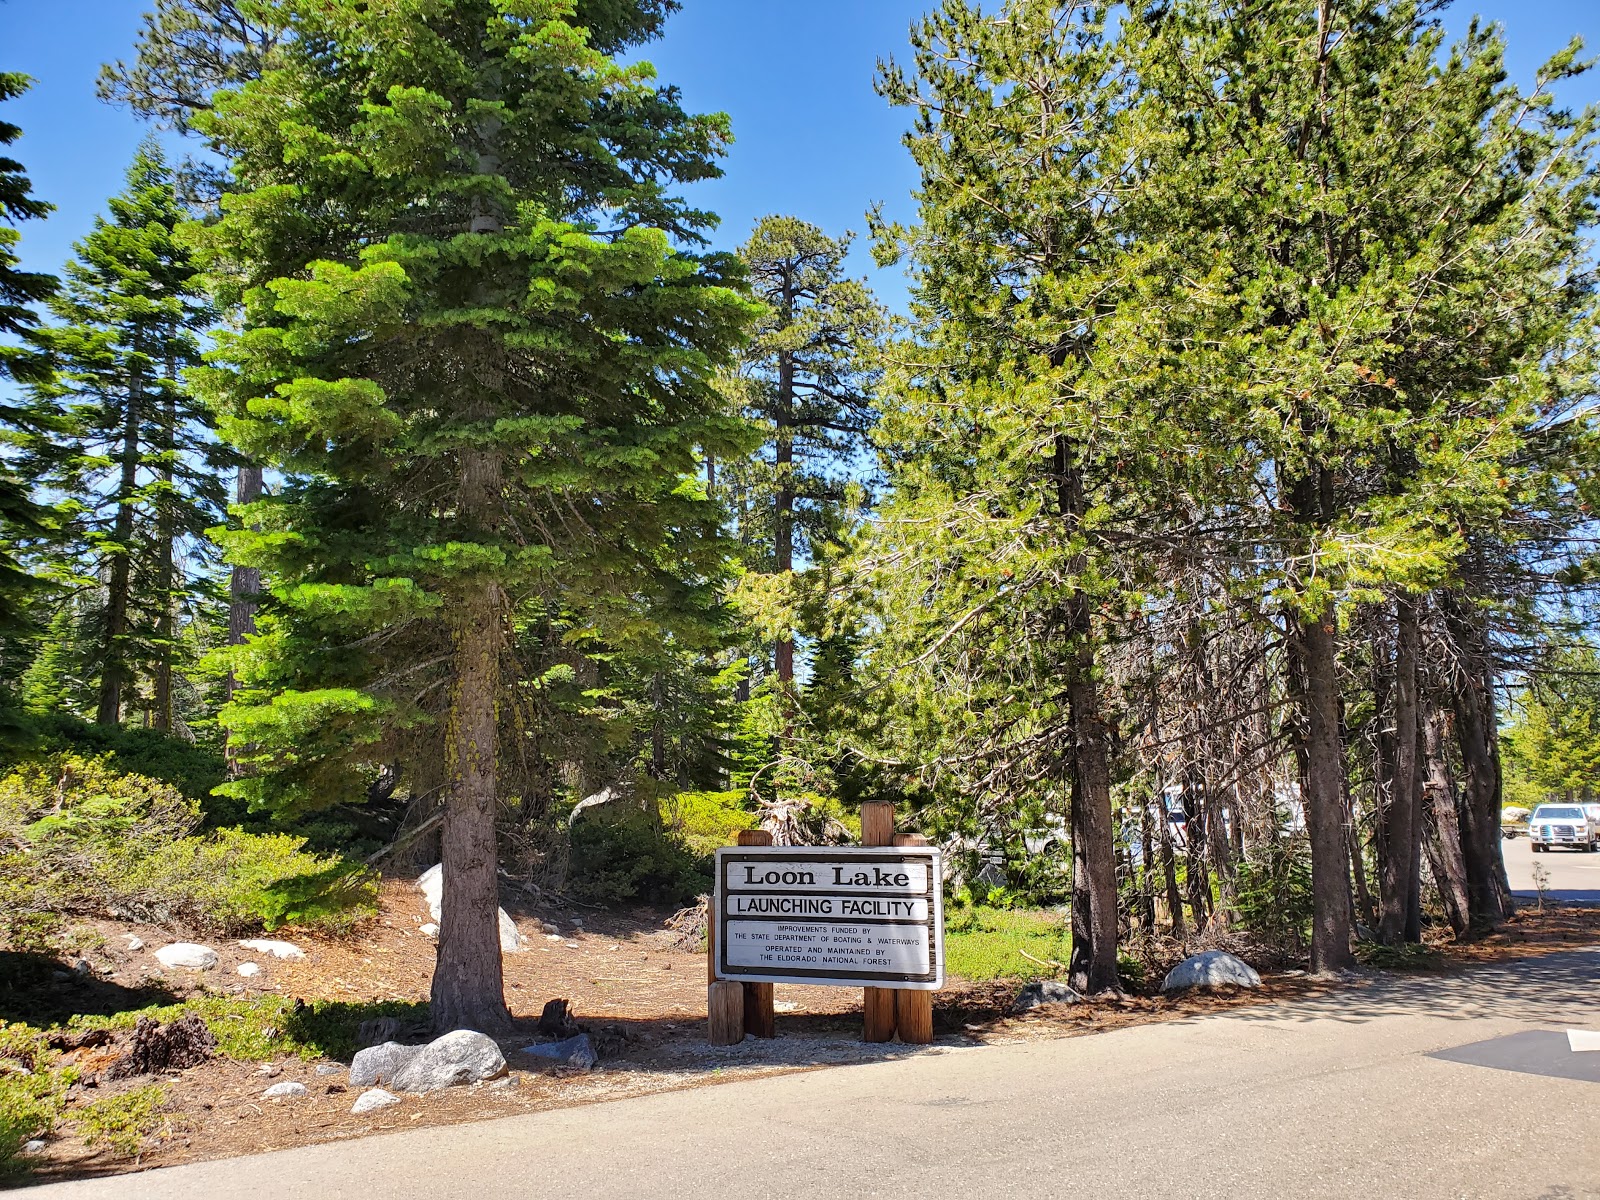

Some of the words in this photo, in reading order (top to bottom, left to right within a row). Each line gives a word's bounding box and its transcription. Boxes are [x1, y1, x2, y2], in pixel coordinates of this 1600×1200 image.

[744, 866, 816, 884] Loon
[832, 867, 909, 887] Lake
[738, 898, 832, 914] LAUNCHING
[842, 900, 915, 916] FACILITY
[822, 956, 858, 964] NATIONAL
